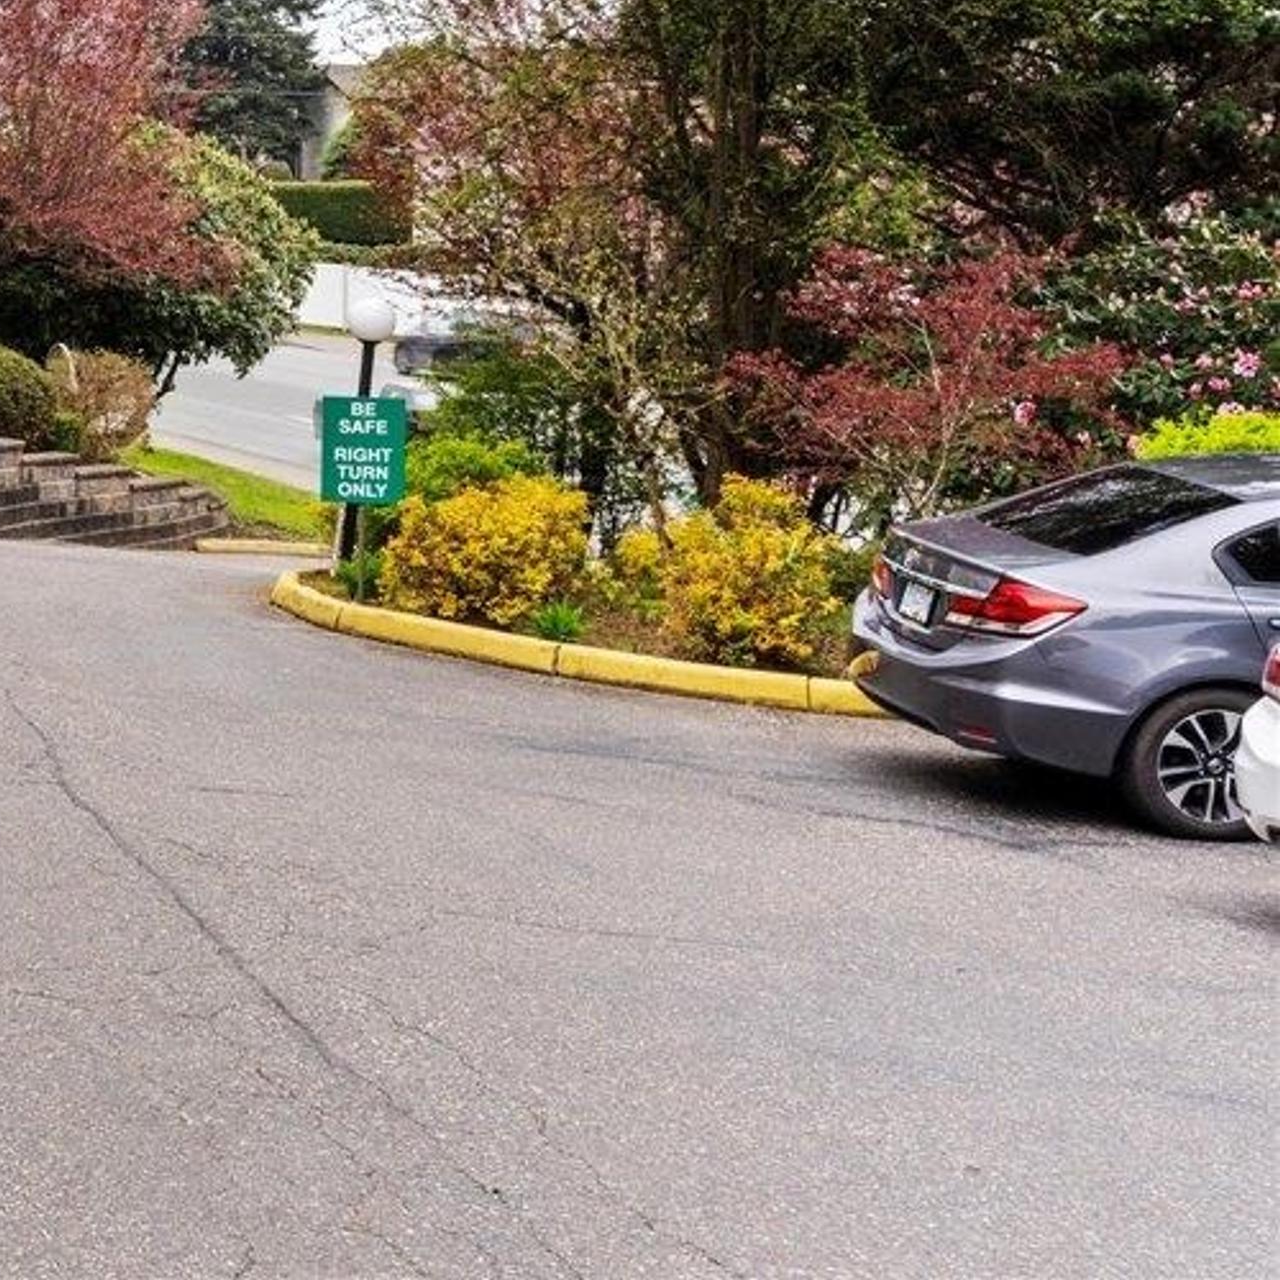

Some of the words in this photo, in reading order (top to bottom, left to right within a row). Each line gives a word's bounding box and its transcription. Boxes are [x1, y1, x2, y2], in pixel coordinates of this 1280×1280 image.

[350, 402, 376, 416] BE
[339, 419, 388, 434] SAFE
[334, 447, 392, 462] RIGHT
[337, 465, 388, 480] TURN
[337, 482, 388, 498] ONLY
